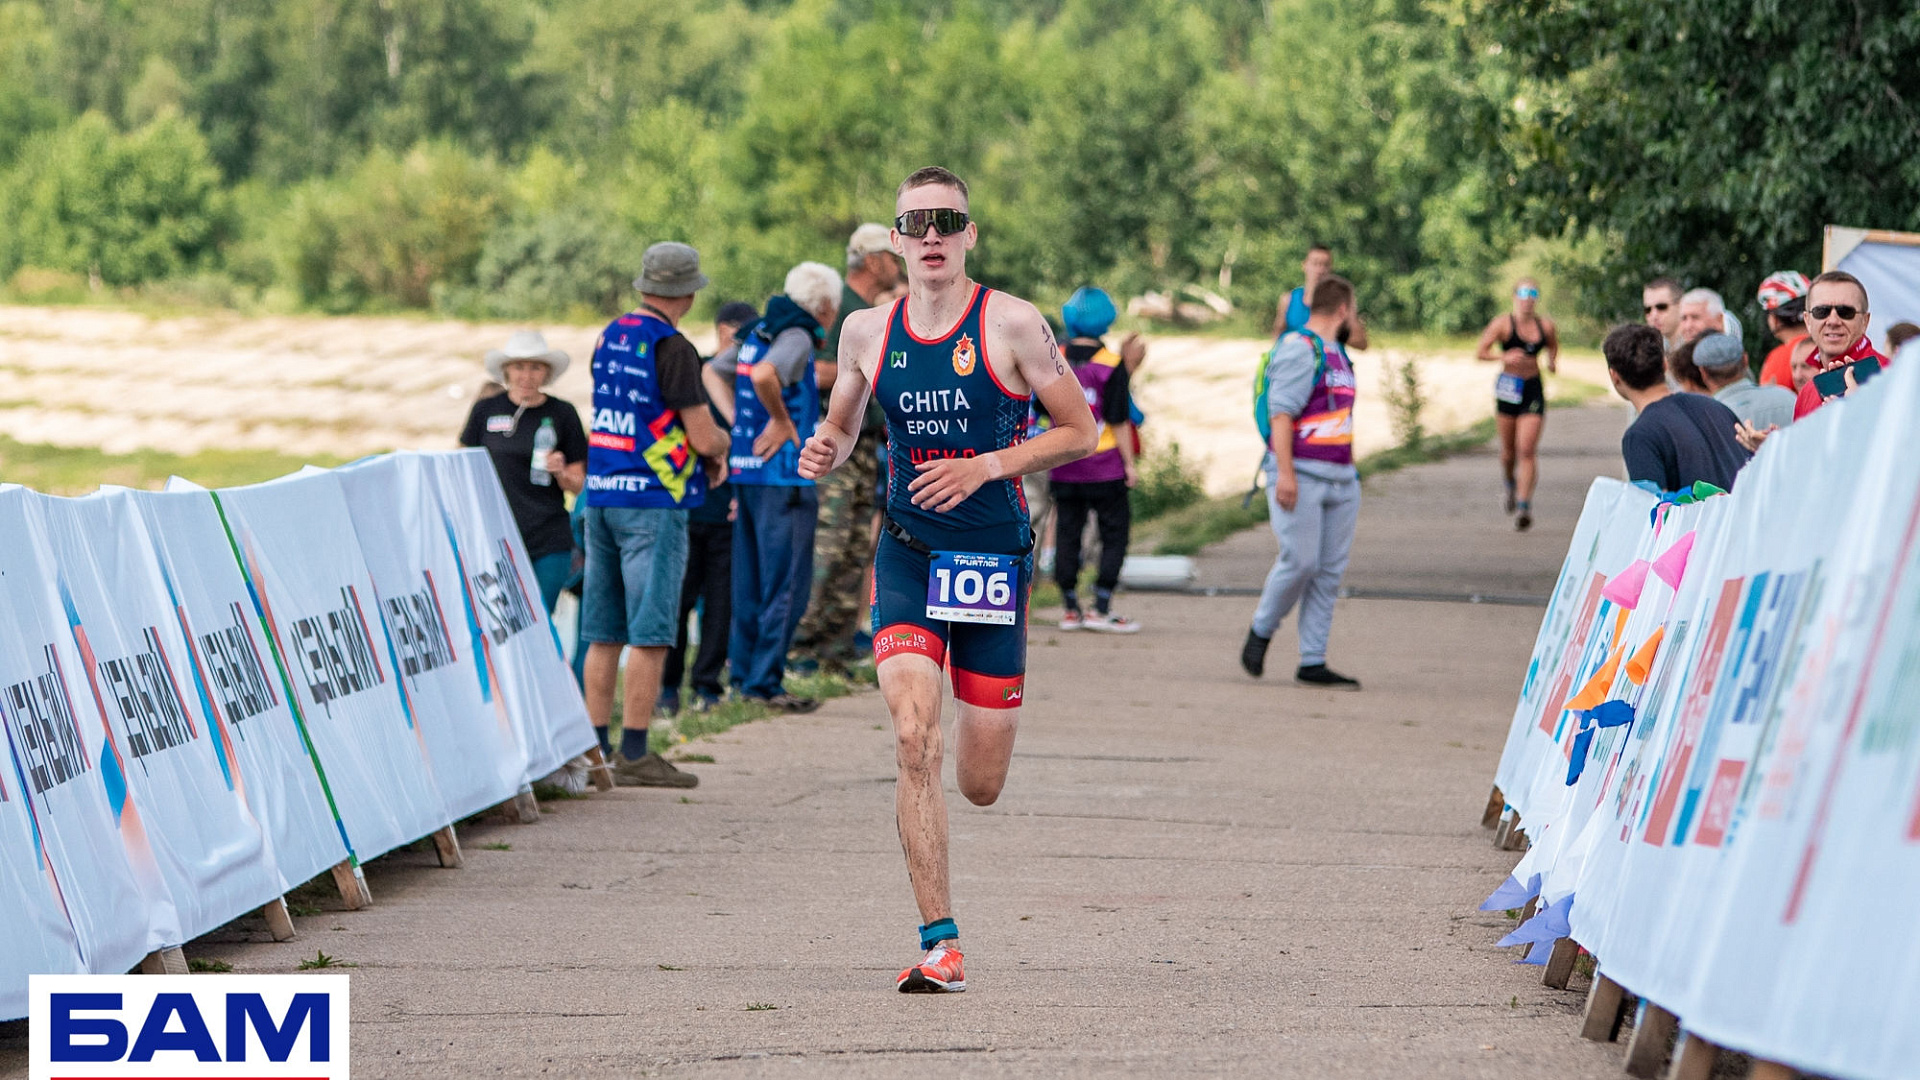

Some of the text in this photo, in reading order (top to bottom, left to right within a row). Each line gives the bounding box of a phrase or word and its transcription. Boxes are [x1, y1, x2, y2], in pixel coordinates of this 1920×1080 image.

[1041, 324, 1065, 376] 106
[899, 387, 971, 413] CHITA
[590, 406, 636, 436] АМ
[906, 417, 968, 435] EPOV V
[936, 568, 1011, 606] 106
[874, 639, 928, 659] ROTHERS
